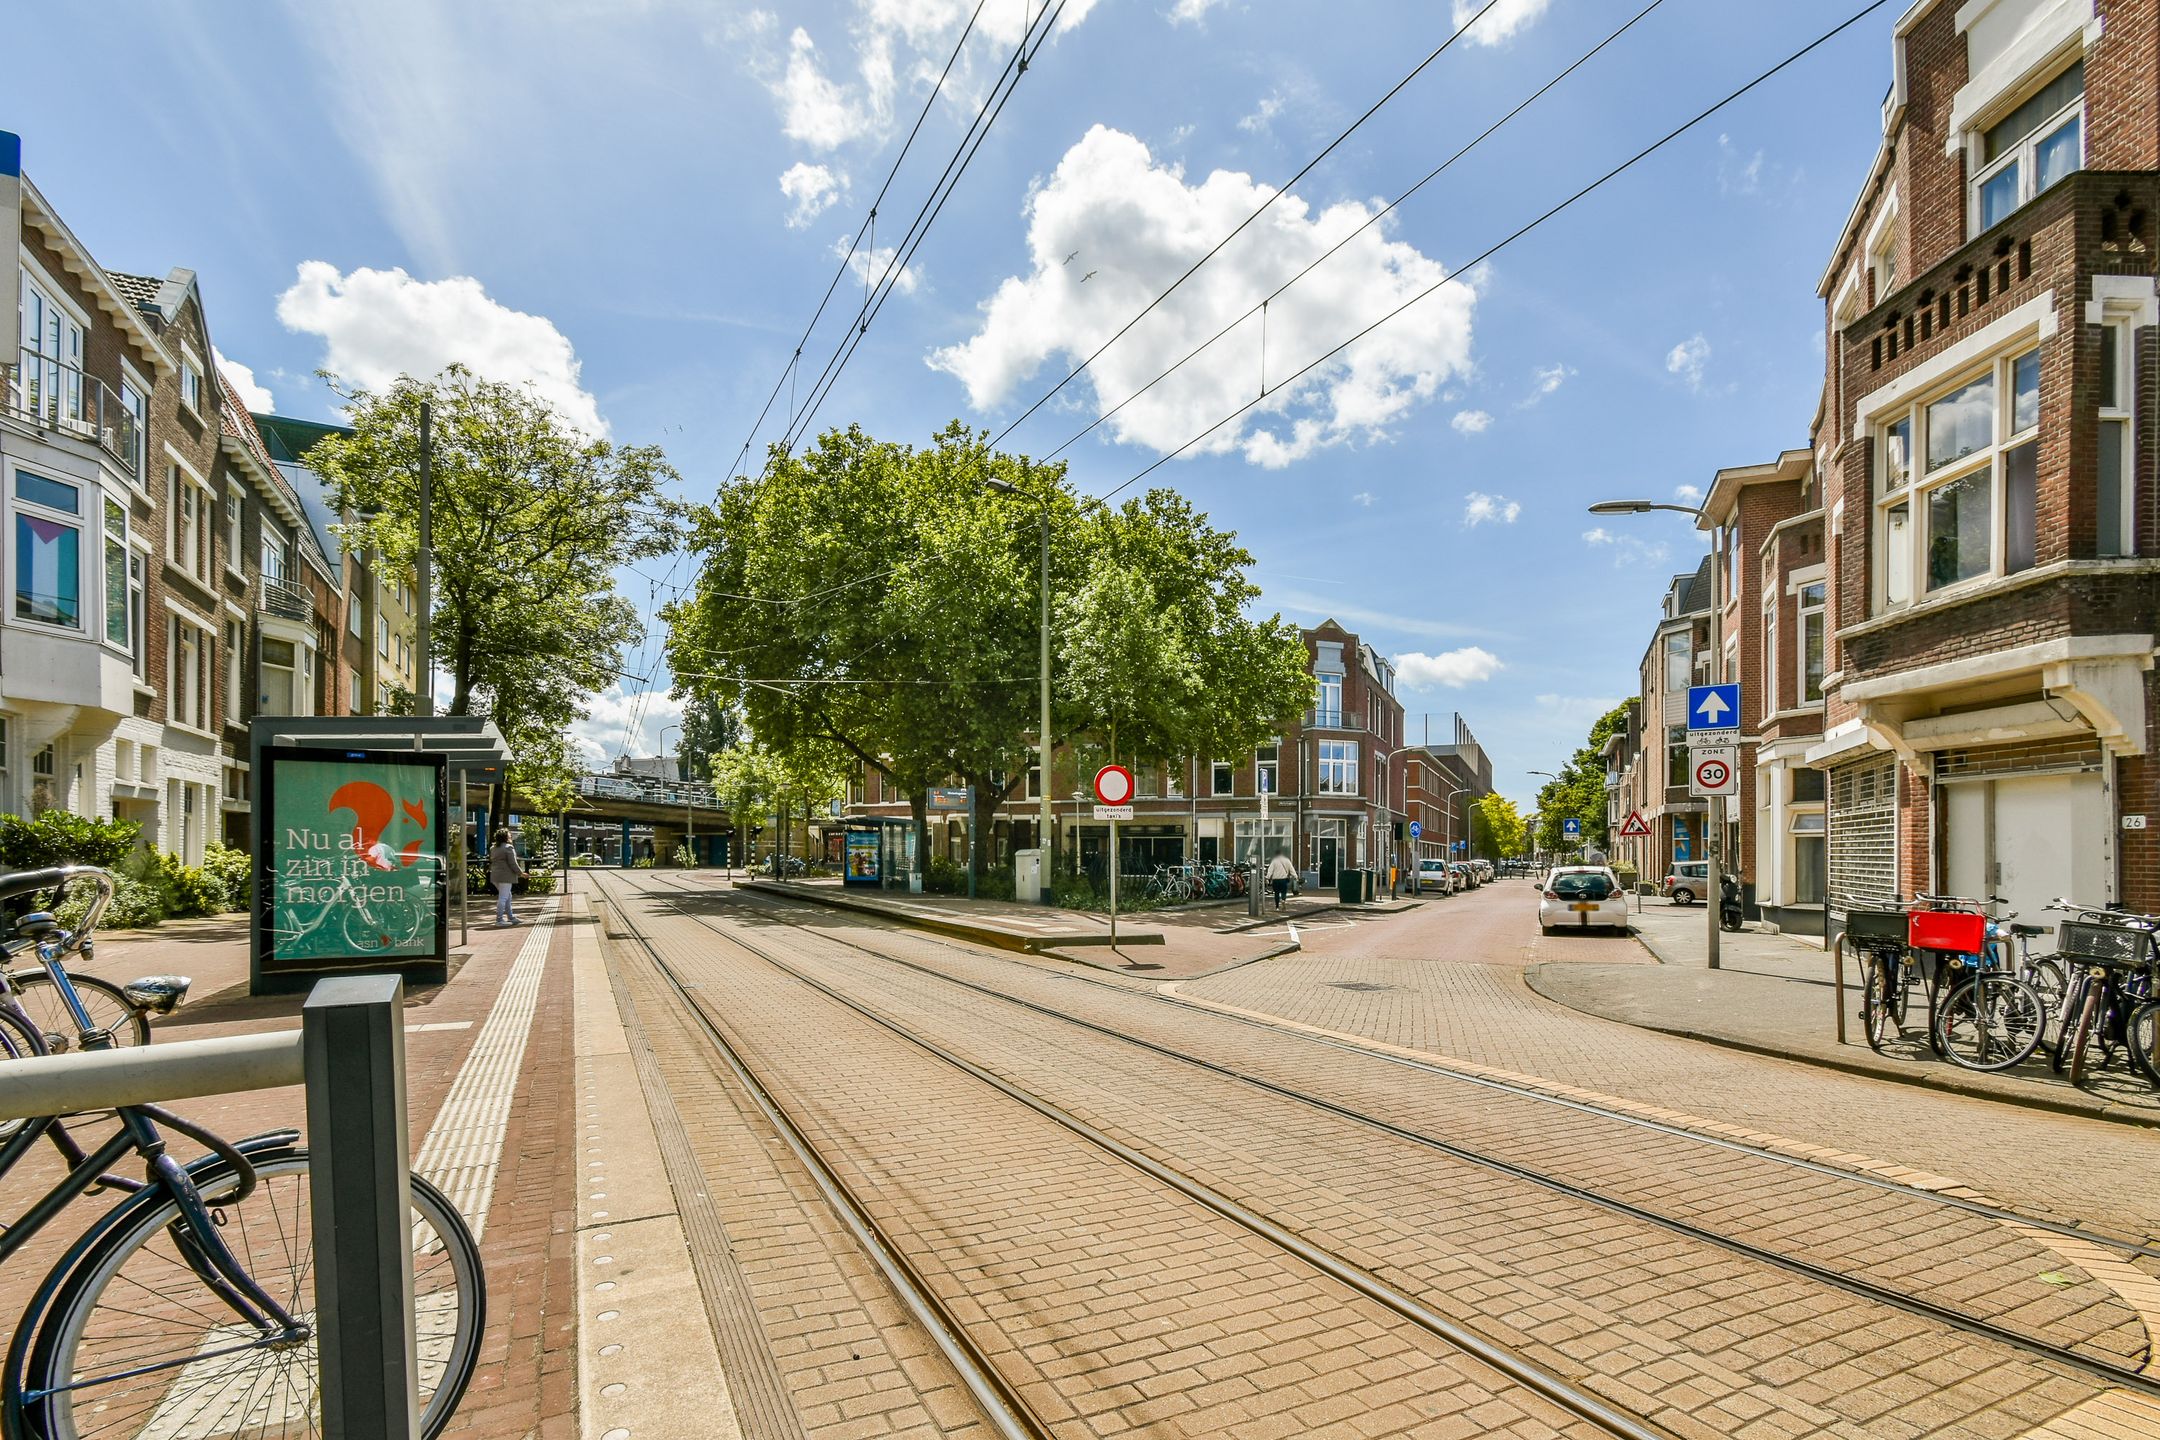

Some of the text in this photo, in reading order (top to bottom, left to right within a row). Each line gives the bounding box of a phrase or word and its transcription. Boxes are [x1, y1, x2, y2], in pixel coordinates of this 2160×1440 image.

[1690, 729, 1738, 737] uitgezonderd
[1702, 769, 1724, 780] 30
[2126, 817, 2141, 828] 26
[286, 826, 365, 850] Nu al
[286, 855, 370, 877] zin in
[286, 884, 406, 908] morgen
[357, 936, 425, 948] asn bank
